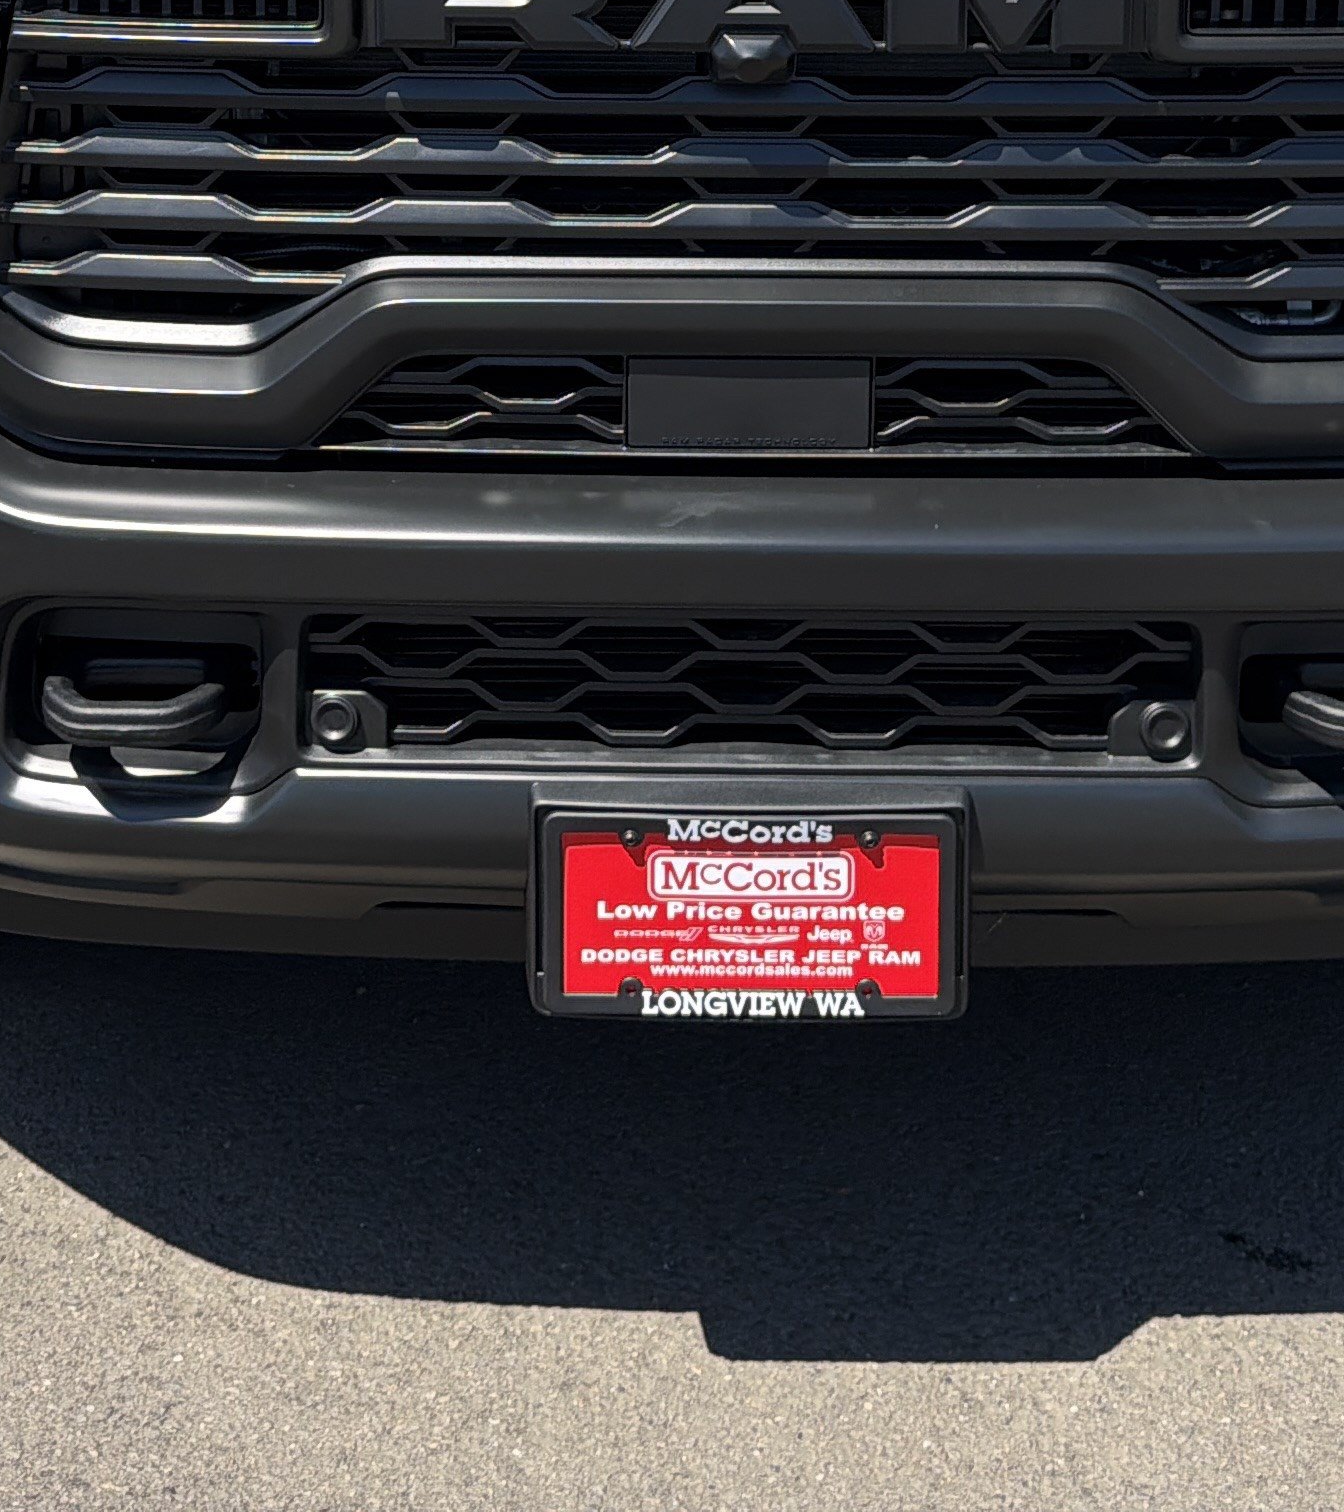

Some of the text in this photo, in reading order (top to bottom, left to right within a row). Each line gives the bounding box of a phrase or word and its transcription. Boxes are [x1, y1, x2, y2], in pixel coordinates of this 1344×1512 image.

[667, 819, 833, 844] McCord's
[661, 861, 841, 891] McCord's
[596, 900, 905, 922] Low Price Guarantee
[707, 925, 801, 934] CHRYSLER
[806, 924, 852, 945] Jeep
[580, 948, 921, 966] DODGE CHRYSLER JEEP RAM
[650, 963, 853, 977] www.mccordsales.com
[641, 990, 865, 1017] LONGVIEW WA
